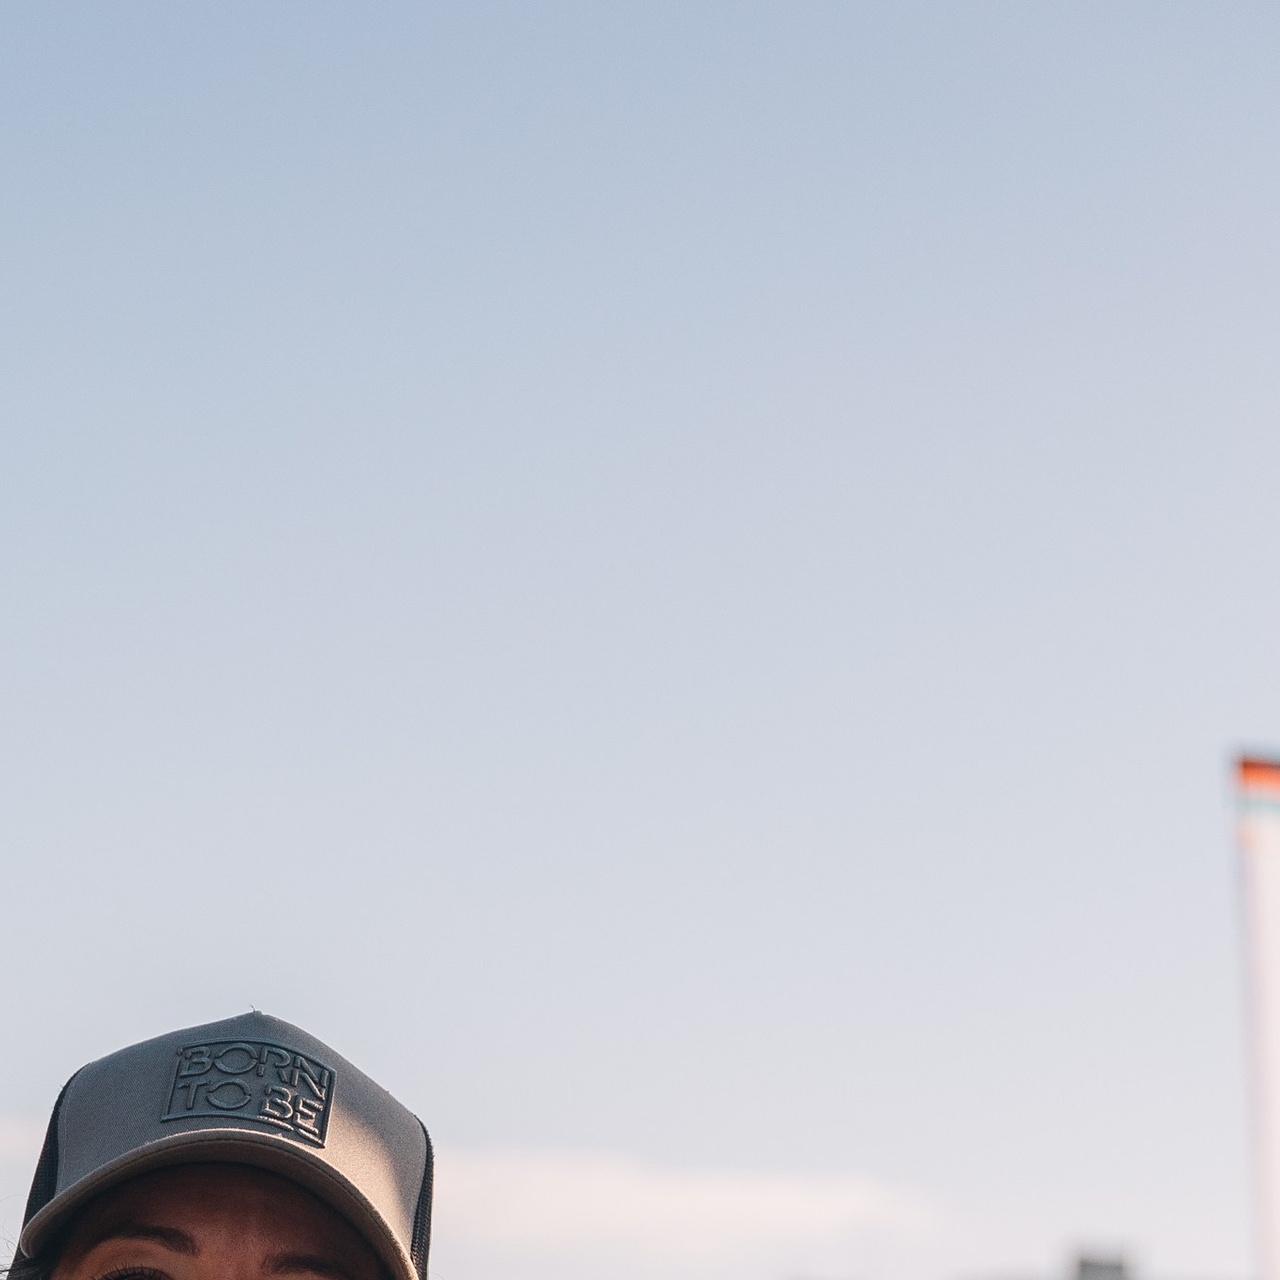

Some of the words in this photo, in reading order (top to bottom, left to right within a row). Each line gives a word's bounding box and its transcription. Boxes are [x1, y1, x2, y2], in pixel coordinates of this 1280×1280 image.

[179, 1043, 329, 1101] BORN
[178, 1078, 252, 1111] TO
[260, 1085, 324, 1135] BE
